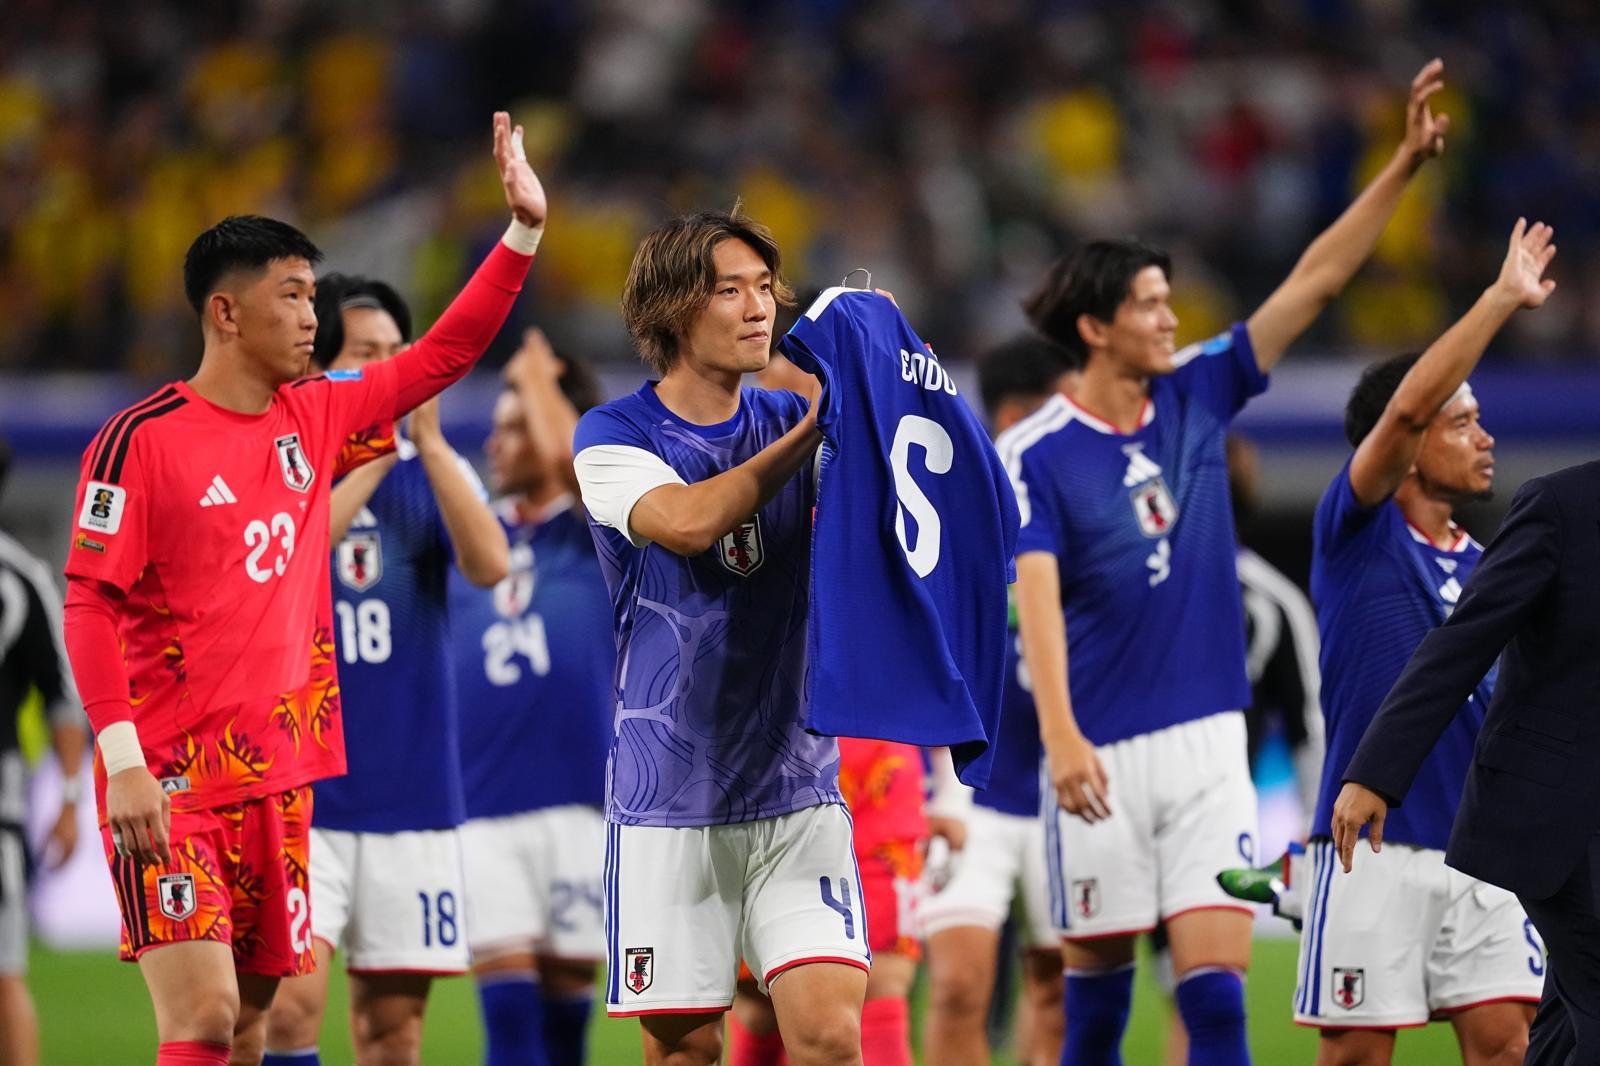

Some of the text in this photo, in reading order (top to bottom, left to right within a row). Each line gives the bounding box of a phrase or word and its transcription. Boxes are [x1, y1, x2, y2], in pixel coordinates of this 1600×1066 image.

[243, 512, 295, 583] 23
[336, 599, 392, 664] 18
[482, 612, 550, 686] 24
[287, 887, 312, 955] 2
[419, 890, 457, 947] 18
[820, 876, 855, 939] 4
